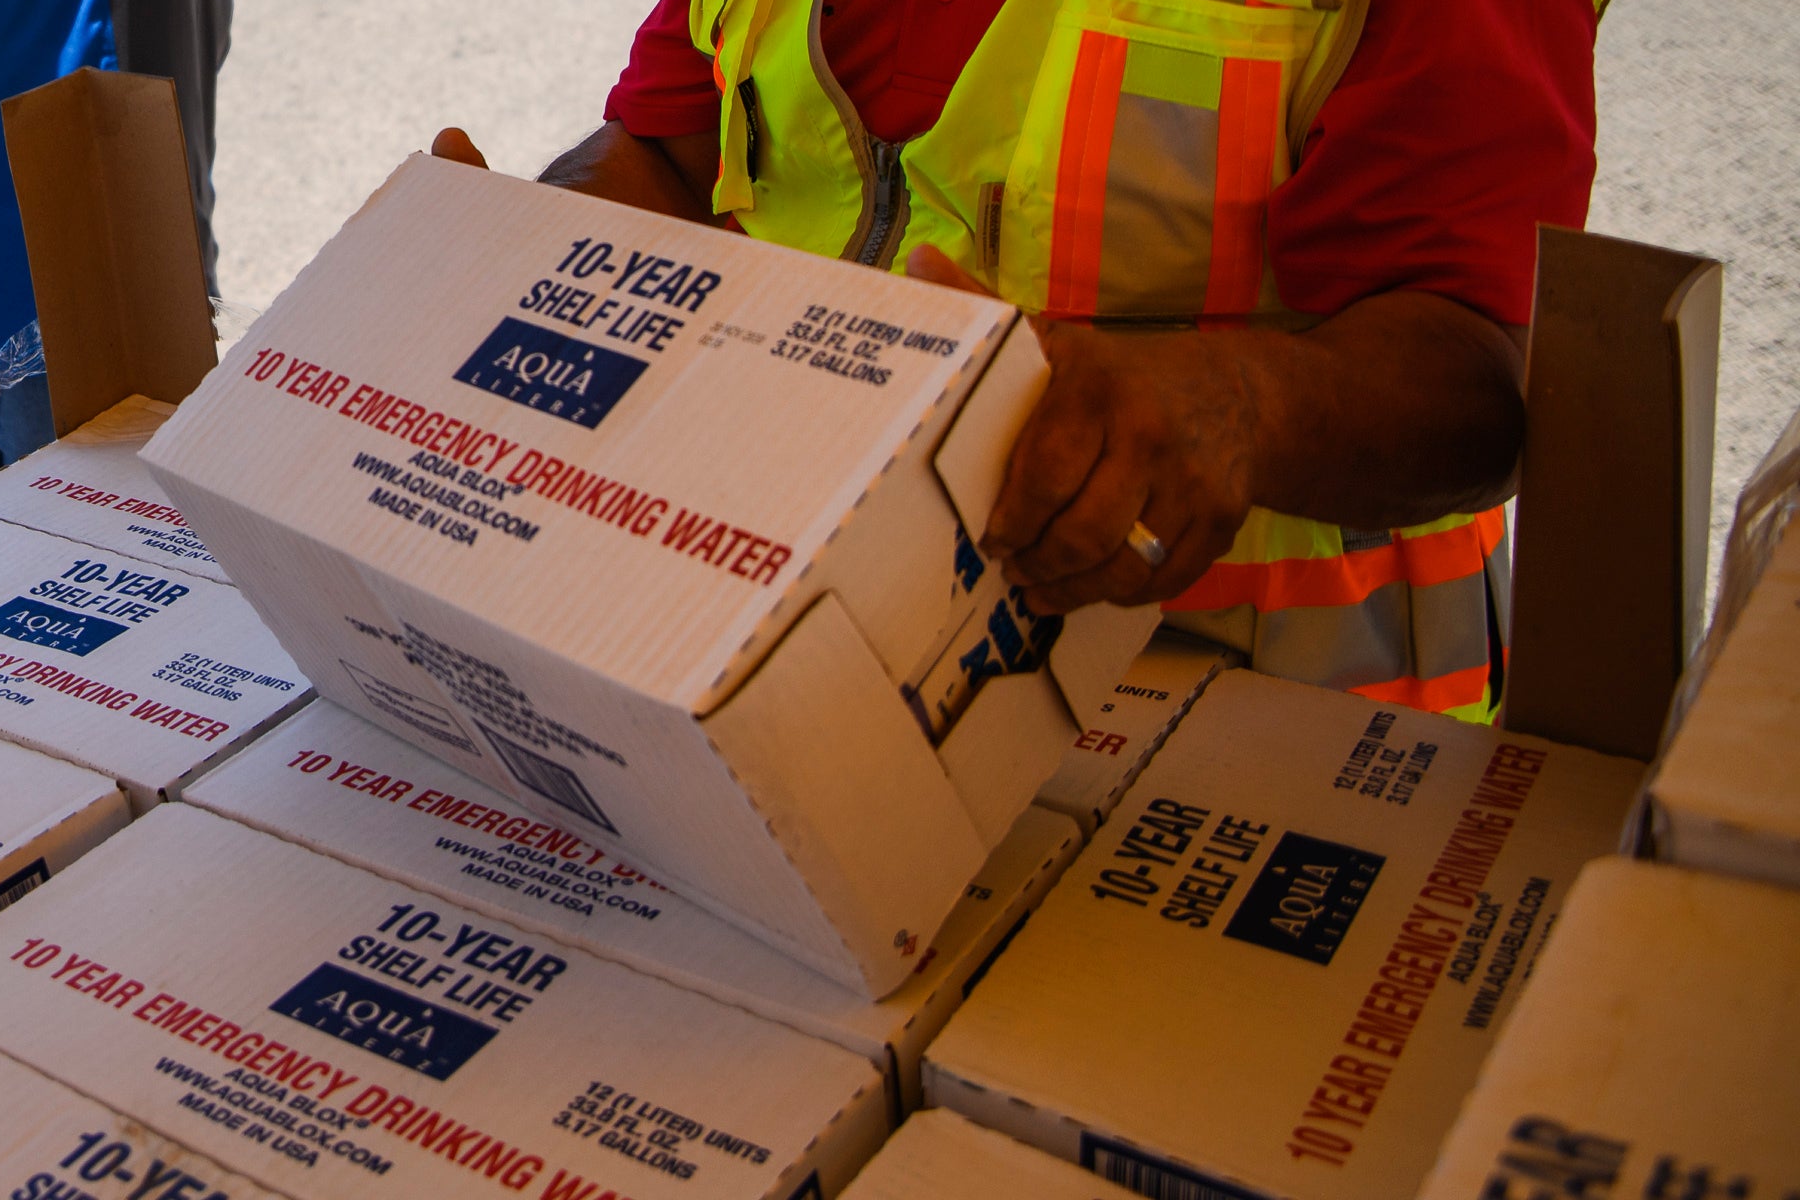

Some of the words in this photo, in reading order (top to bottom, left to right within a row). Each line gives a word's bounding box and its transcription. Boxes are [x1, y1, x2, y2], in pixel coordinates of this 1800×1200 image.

[556, 238, 722, 313] 10-YEAR
[518, 279, 620, 329] SHELF
[605, 306, 685, 352] LIFE
[785, 321, 828, 344] 33.8
[823, 331, 848, 354] FL.
[852, 340, 882, 362] OZ.
[803, 304, 828, 323] 12
[844, 316, 904, 346] LITER)
[902, 331, 959, 357] UNITS
[493, 345, 594, 396] AQUA
[770, 338, 812, 362] 3.17
[808, 350, 892, 386] GALLONS
[29, 476, 63, 490] 10
[57, 482, 120, 507] YEAR
[244, 347, 286, 382] 10
[275, 357, 350, 408] YEAR
[338, 383, 519, 474] EMERGENCY
[505, 448, 669, 537] DRINKING
[661, 508, 792, 586] WATER
[407, 450, 460, 482] AQUA
[352, 451, 540, 542] WWW.AQUABLOX.COM
[368, 486, 424, 521] MADE
[418, 508, 444, 530] IN
[439, 517, 478, 546] USA
[142, 539, 185, 556] MADE
[185, 551, 203, 559] IN
[29, 580, 110, 609] SHELF
[96, 598, 160, 624] LIFE
[60, 559, 190, 607] 10-YEAR
[6, 610, 85, 640] AQUA
[10, 660, 139, 711] DRINKING
[129, 698, 230, 742] WATER
[151, 668, 185, 684] 3.17
[180, 678, 243, 702] GALLONS
[164, 660, 198, 676] 33.8
[192, 669, 212, 682] FL.
[213, 675, 245, 689] OZ.
[180, 652, 200, 664] 12
[210, 662, 255, 682] LITER)
[252, 674, 296, 692] UNITS
[1114, 684, 1169, 700] UNITS
[287, 750, 332, 773] 10
[327, 760, 415, 802] YEAR
[1470, 743, 1548, 811] WATER
[434, 836, 663, 921] WWW.AQUABLOX.COM
[497, 842, 557, 869] AQUA
[1090, 798, 1211, 907] 10-YEAR
[1159, 856, 1238, 929] SHELF
[1202, 814, 1270, 864] LIFE
[1420, 809, 1515, 909] DRINKING
[461, 863, 526, 893] MADE
[523, 882, 550, 899] IN
[549, 892, 594, 916] USA
[1270, 864, 1339, 938] AQUA
[377, 904, 568, 993] 10-YEAR
[1446, 940, 1486, 985] AQUA
[1463, 876, 1552, 1029] WWW.AQUABLOX.COM
[338, 935, 456, 989] SHELF
[443, 974, 534, 1023] LIFE
[1344, 903, 1464, 1060] EMERGENCY
[316, 990, 435, 1048] AQUA
[10, 938, 62, 969] 10
[50, 953, 145, 1009] YEAR
[132, 993, 359, 1100] EMERGENCY
[344, 1085, 544, 1191] DRINKING
[224, 1068, 289, 1103] AQUA
[1305, 1054, 1393, 1128] YEAR
[155, 1057, 393, 1176] WWW.AQUABLOX.COM
[178, 1092, 248, 1131] MADE
[242, 1123, 273, 1144] IN
[270, 1135, 319, 1168] USA
[568, 1095, 617, 1124] 33.8
[586, 1082, 615, 1102] 12
[635, 1102, 704, 1141] LITER)
[703, 1129, 771, 1165] UNITS
[552, 1110, 602, 1137] 3.17
[598, 1130, 697, 1178] GALLONS
[1286, 1126, 1354, 1167] 10
